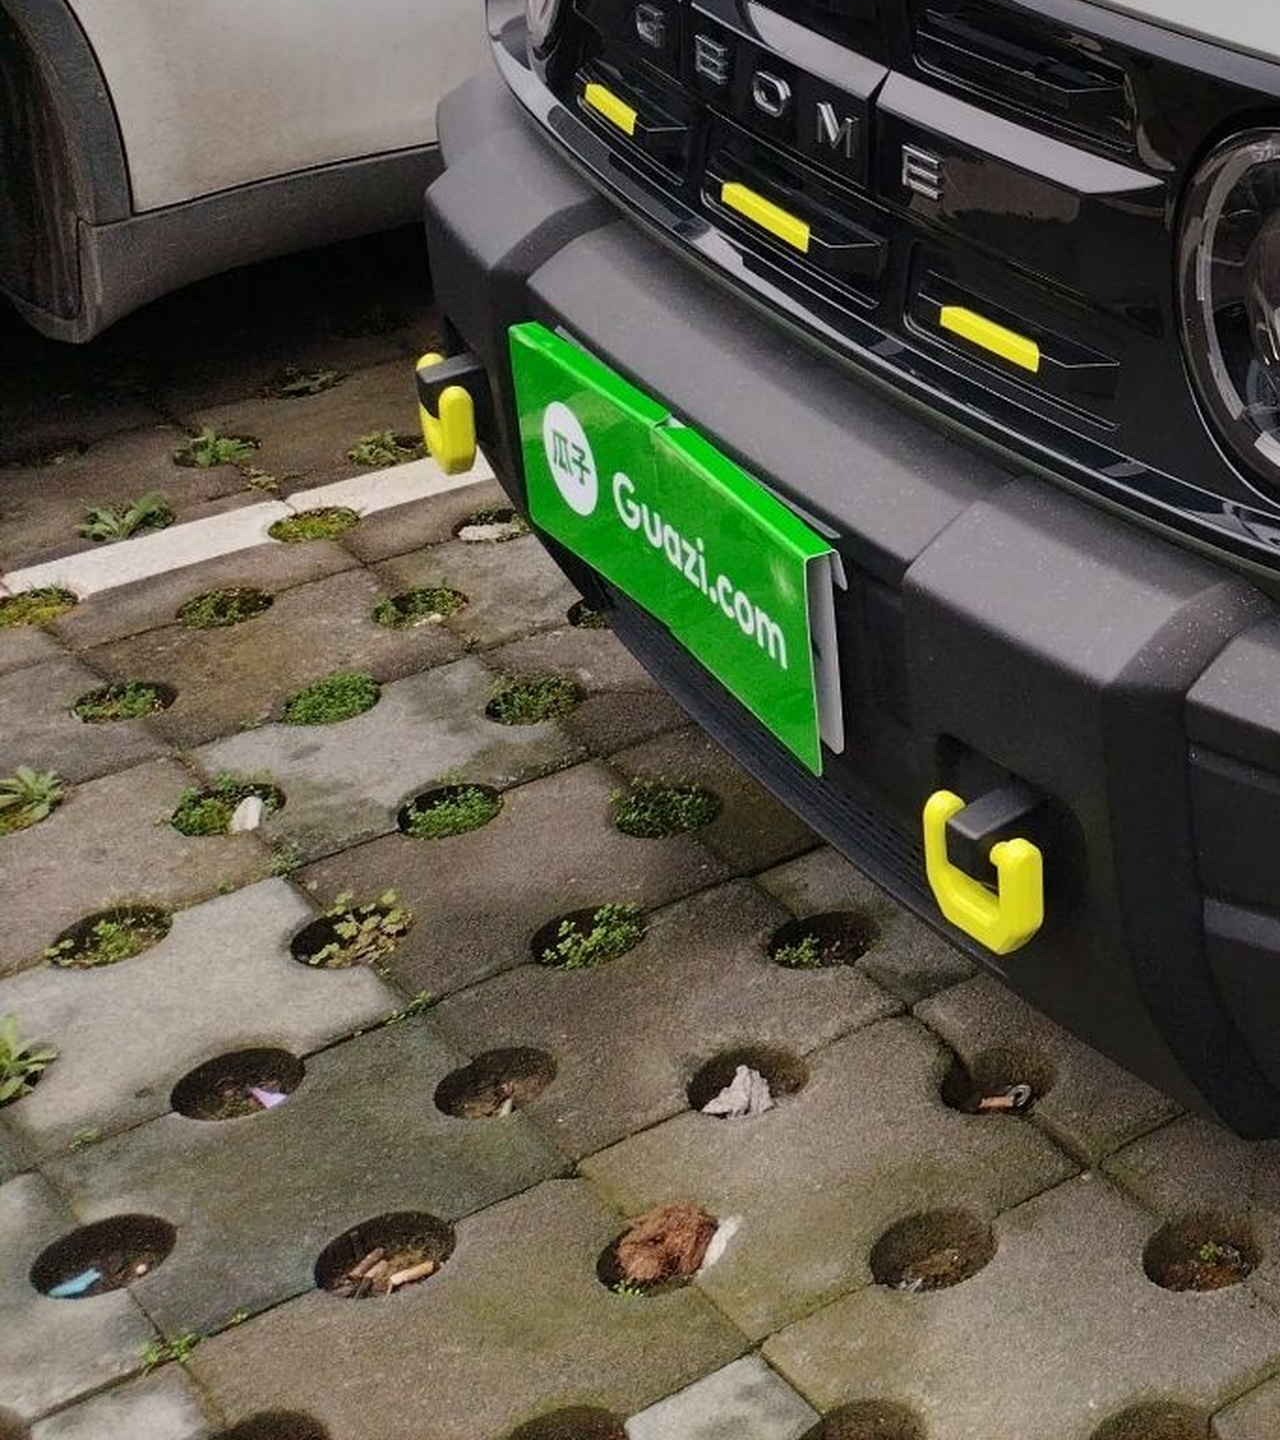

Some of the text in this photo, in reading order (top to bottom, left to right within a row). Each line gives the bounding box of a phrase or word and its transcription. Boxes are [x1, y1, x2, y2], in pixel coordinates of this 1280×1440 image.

[635, 3, 943, 201] GEOME
[552, 430, 592, 486] 瓜子
[612, 471, 788, 671] Guazi.com
